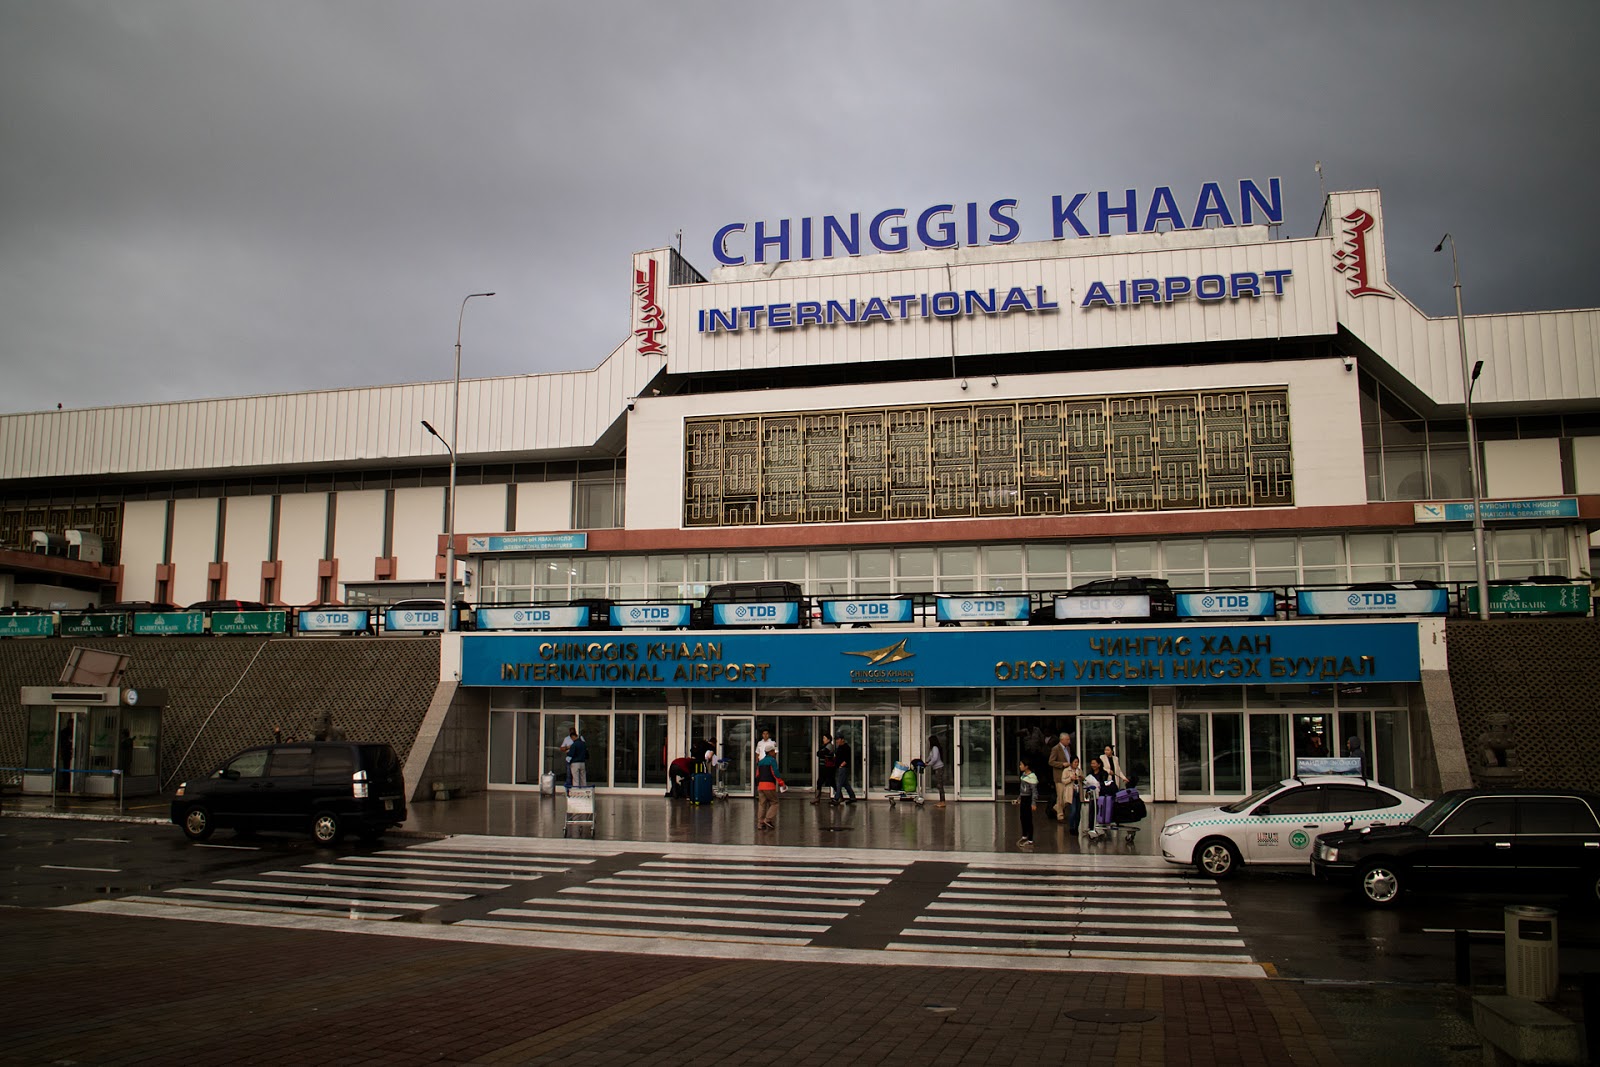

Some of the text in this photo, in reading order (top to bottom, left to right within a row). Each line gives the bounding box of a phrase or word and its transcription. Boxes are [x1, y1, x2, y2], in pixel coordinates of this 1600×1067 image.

[712, 177, 1283, 268] CHINGGIS KHAAN
[698, 268, 1292, 333] INTERNATIONAL AIRPORT
[1532, 500, 1560, 508] НИСЛЭГ
[1465, 509, 1560, 519] INTRNATIONAL DEPARTURES
[1215, 595, 1250, 608] TDB
[1361, 593, 1397, 606] TDB
[1521, 601, 1546, 609] БАНК
[747, 605, 777, 617] TDB
[859, 603, 889, 614] TDB
[975, 600, 1006, 612] TDB
[325, 613, 349, 624] TDB
[414, 612, 439, 623] TDB
[525, 610, 551, 621] TDB
[641, 607, 670, 618] TDB
[1089, 634, 1272, 658] ЧИНГИС ХААН
[538, 642, 722, 663] CHINGGIS KHAAN
[501, 662, 771, 683] INTERNATIONAL AIRPORT
[994, 654, 1377, 681] ОЛОН УЛСЫН НИСЭХ БУУДАЛ
[849, 669, 914, 679] CHINGGIS KHAAN
